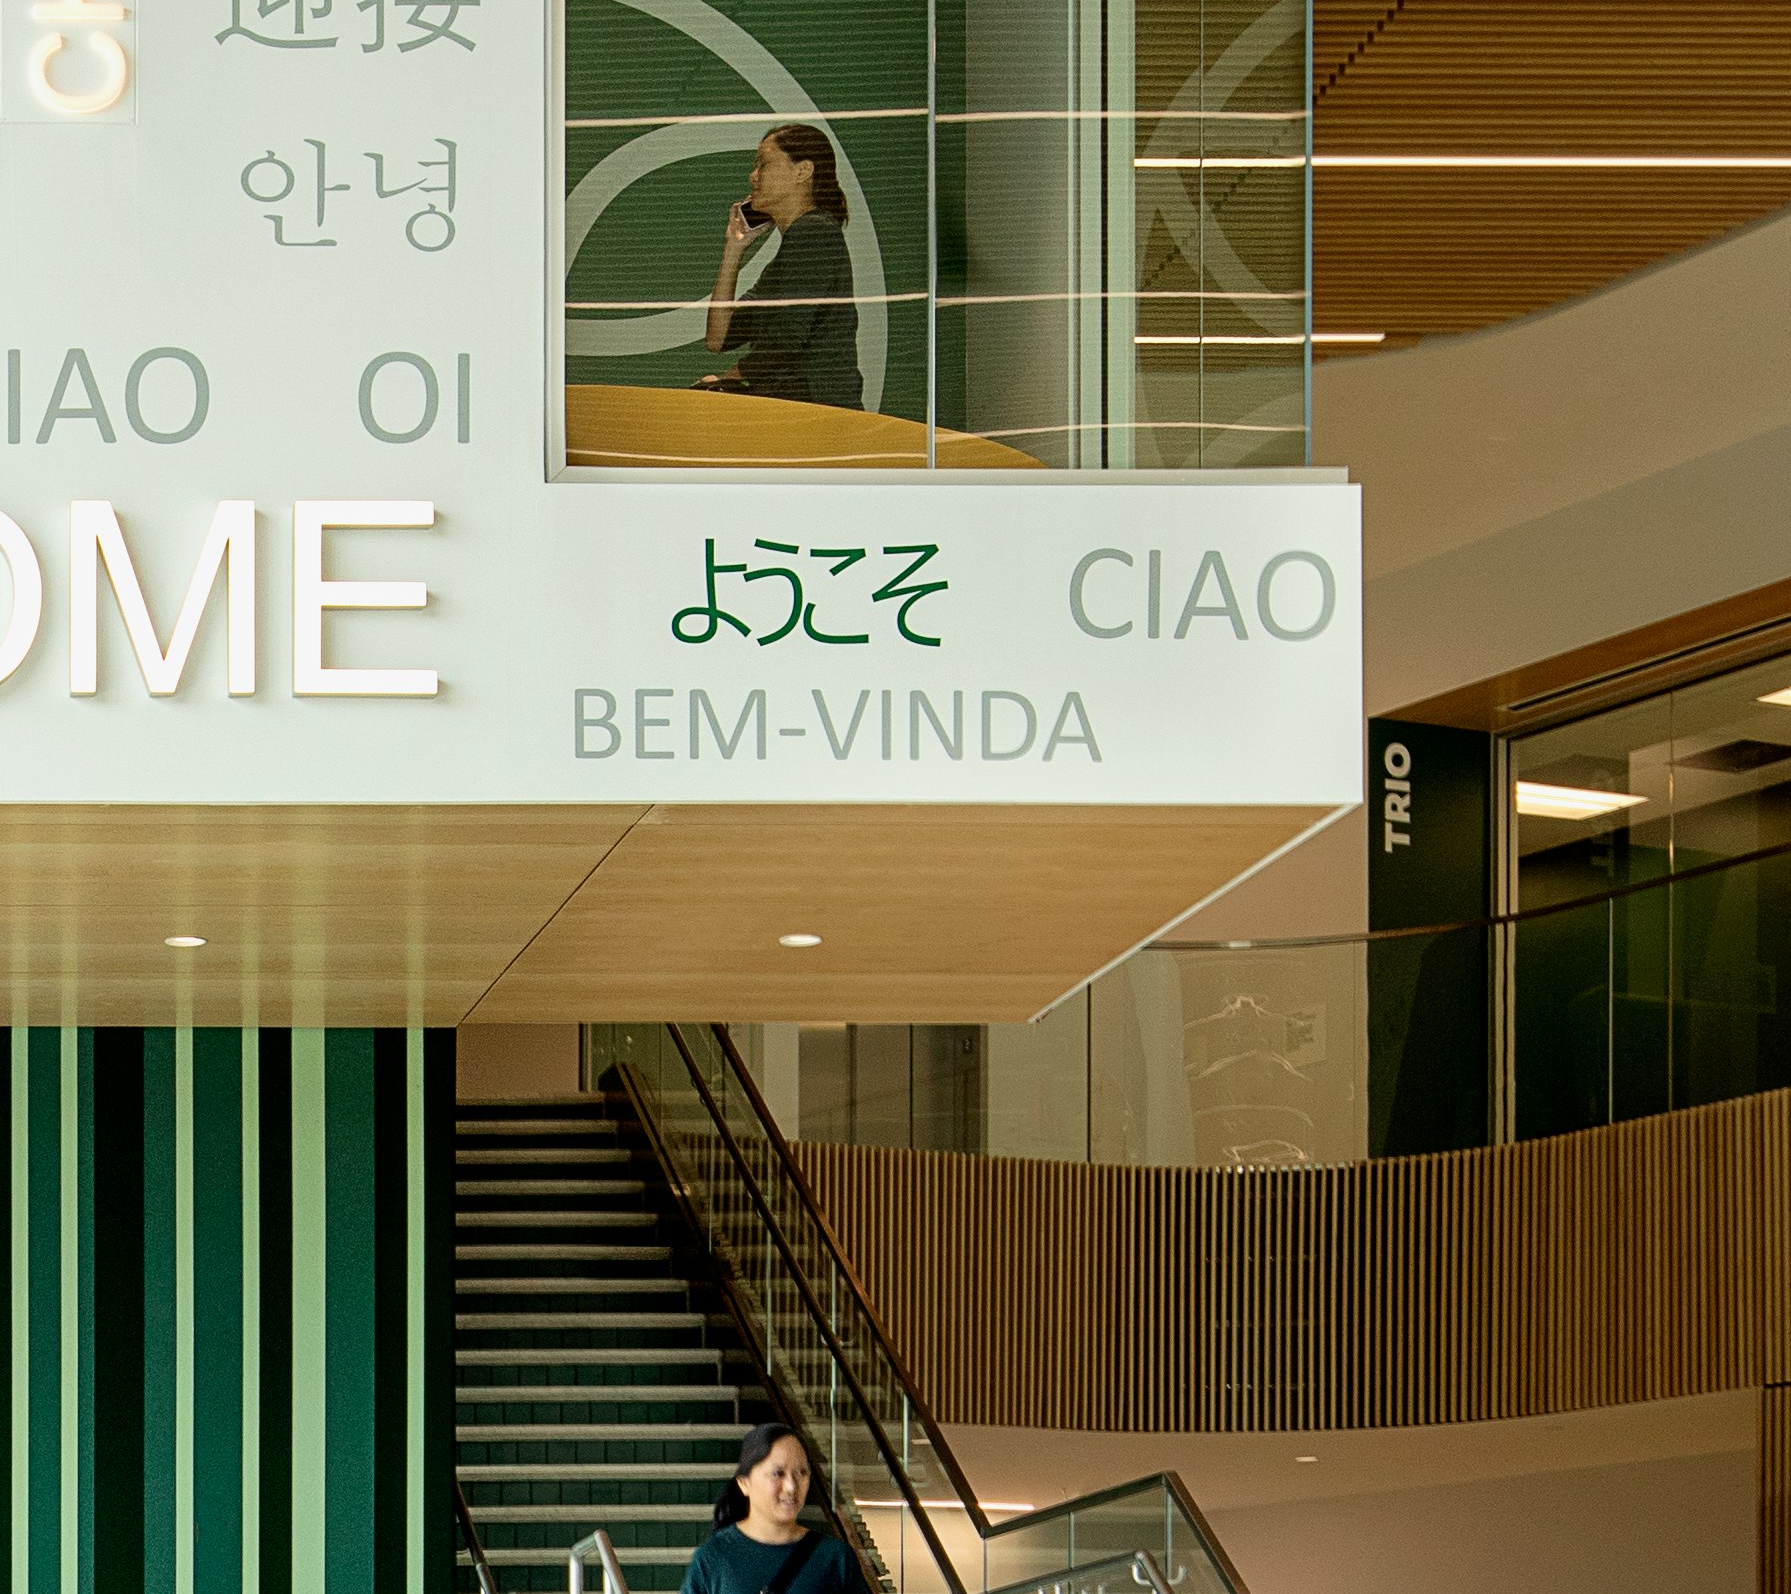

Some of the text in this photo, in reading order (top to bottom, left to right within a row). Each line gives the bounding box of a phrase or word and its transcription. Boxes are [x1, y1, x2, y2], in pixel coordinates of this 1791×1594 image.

[240, 138, 457, 253] 안녕
[358, 352, 471, 445] OI
[671, 539, 949, 647] ようこそ
[1069, 547, 1337, 641] CIAO
[575, 688, 1103, 762] BEM-VINDA
[1384, 742, 1412, 854] TRIO
